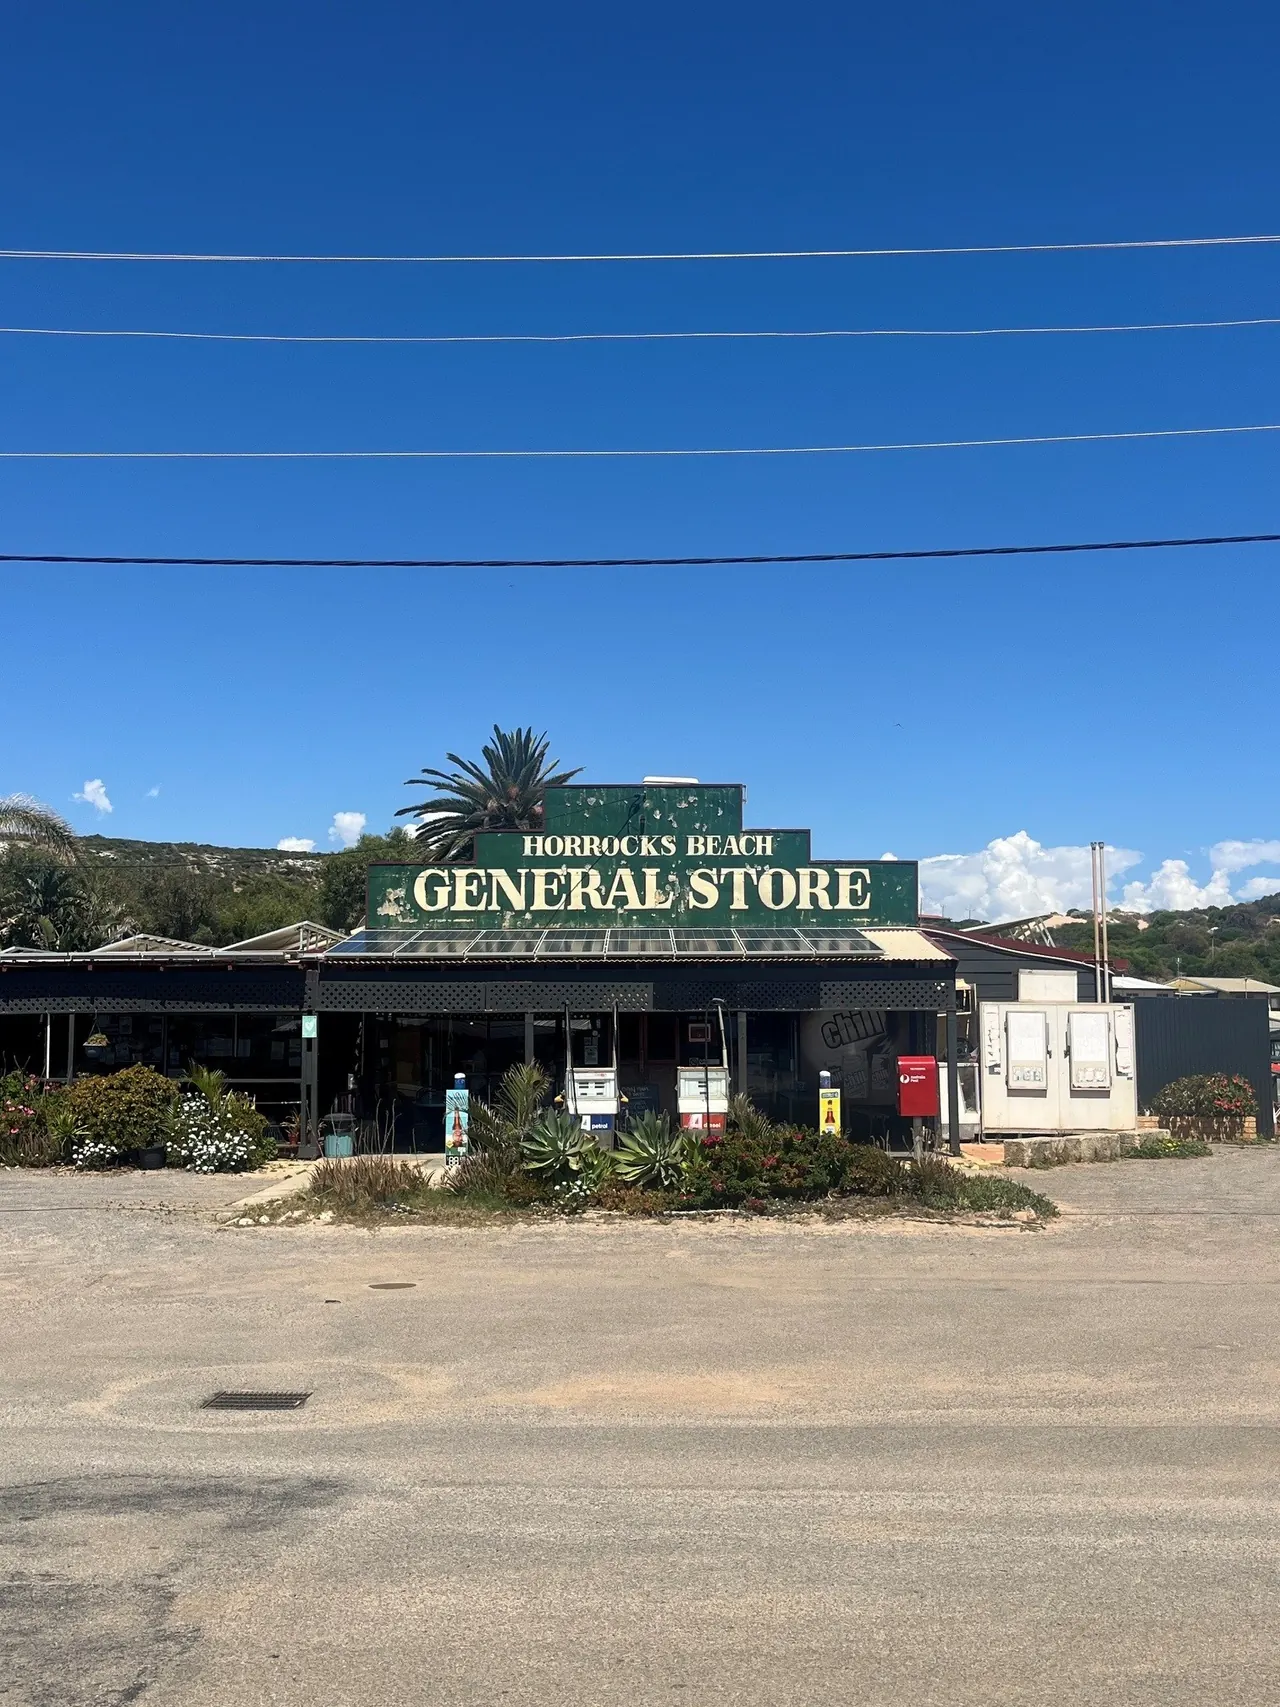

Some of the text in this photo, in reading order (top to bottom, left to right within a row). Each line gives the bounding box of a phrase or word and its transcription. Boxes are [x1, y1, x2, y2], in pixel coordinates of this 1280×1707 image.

[522, 835, 774, 857] HORROCKS BEACH
[413, 868, 871, 912] GENERAL STORE
[820, 1010, 885, 1049] chill
